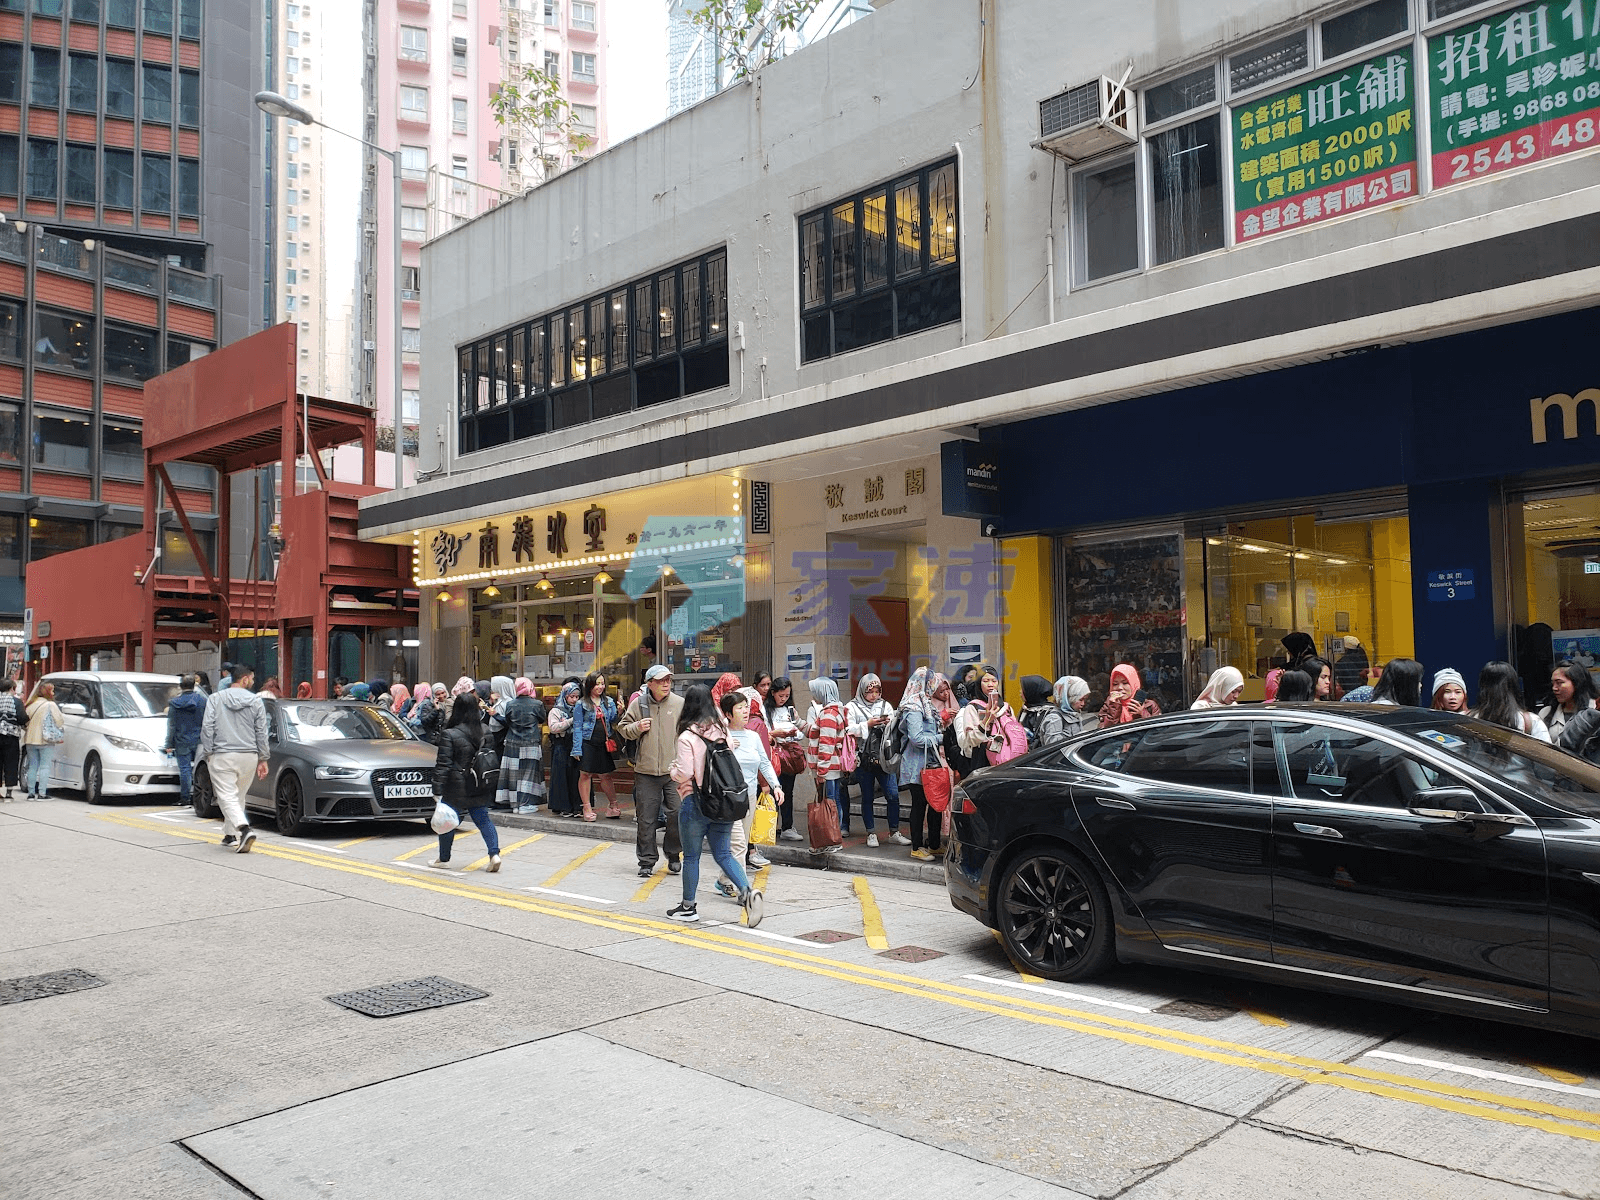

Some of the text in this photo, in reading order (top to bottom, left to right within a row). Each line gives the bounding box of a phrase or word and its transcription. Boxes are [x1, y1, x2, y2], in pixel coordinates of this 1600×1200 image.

[1437, 5, 1557, 86] 招租
[1513, 91, 1568, 121] 9868
[1240, 116, 1303, 150] 水電齊備
[1240, 109, 1411, 182] 建築面積 2000 呎
[1451, 118, 1600, 179] 2543 48
[1242, 169, 1412, 238] 金望企業有限公司
[841, 505, 908, 523] Keswick Court
[1447, 587, 1456, 598] 3
[387, 786, 432, 797] KM 8607
